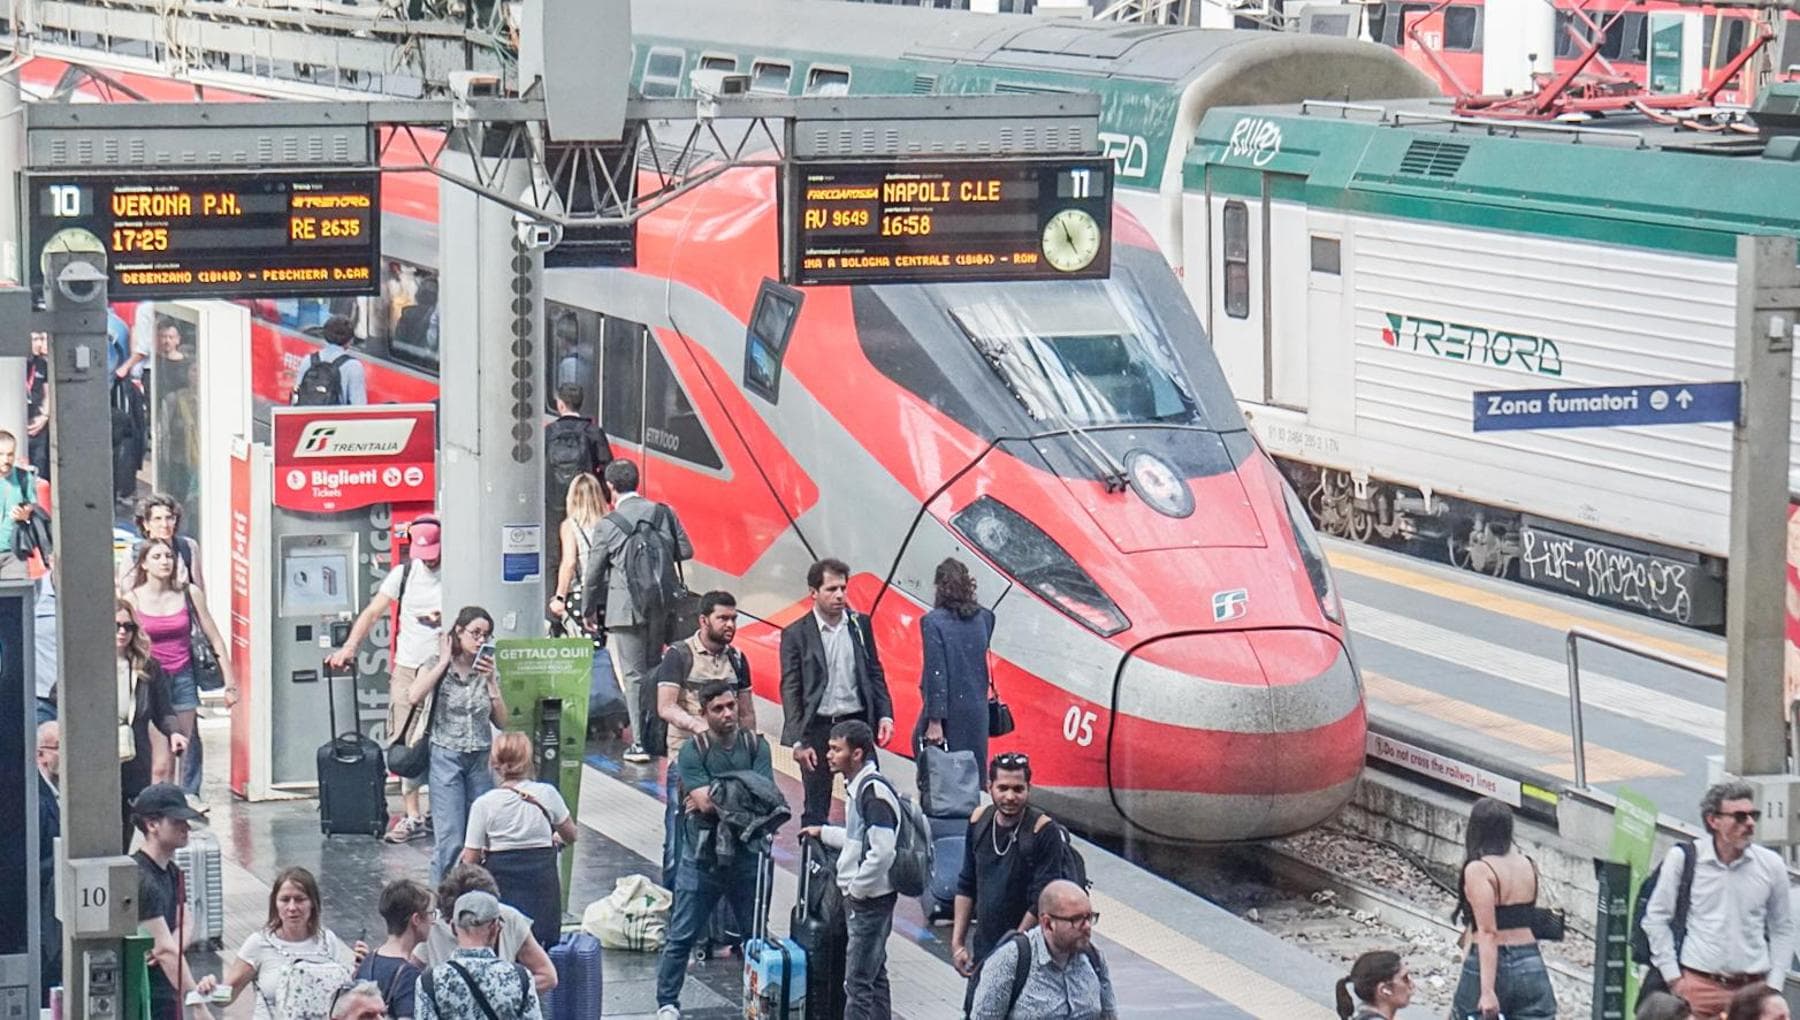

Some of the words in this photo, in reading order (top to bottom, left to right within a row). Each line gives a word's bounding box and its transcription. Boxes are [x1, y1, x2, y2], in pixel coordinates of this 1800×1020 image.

[1097, 132, 1149, 178] RD
[882, 181, 951, 203] NAPOLI
[959, 180, 1001, 202] C.LE
[1070, 168, 1091, 199] 11
[50, 185, 81, 217] 10
[112, 193, 191, 217] VERONA
[202, 193, 242, 216] P.N.
[291, 217, 317, 240] RE
[320, 218, 361, 237] 2635
[804, 208, 828, 230] AV
[832, 210, 870, 227] 9649
[881, 214, 931, 236] 16:58
[112, 228, 169, 252] 17:25
[827, 257, 836, 269] A
[841, 256, 891, 268] BOLOGNA
[895, 253, 951, 267] CENTRALE
[121, 272, 192, 285] DESENZANO
[263, 268, 329, 282] PESCHIERA
[333, 266, 370, 280] D.GAR
[1406, 316, 1562, 376] TRENORD
[1487, 395, 1542, 416] Zona
[1549, 390, 1640, 413] fumatori
[333, 441, 399, 452] TRENITALIA
[311, 468, 378, 489] Biglietti
[312, 487, 342, 498] Tickets
[500, 648, 558, 660] GETTALO
[1063, 705, 1098, 747] 05
[1384, 742, 1395, 757] Do
[1396, 748, 1409, 761] not
[1410, 753, 1430, 769] cross
[1431, 758, 1444, 774] the
[1446, 765, 1475, 787] railway
[1476, 773, 1496, 793] lines
[1767, 801, 1784, 818] 11
[81, 886, 106, 907] 10
